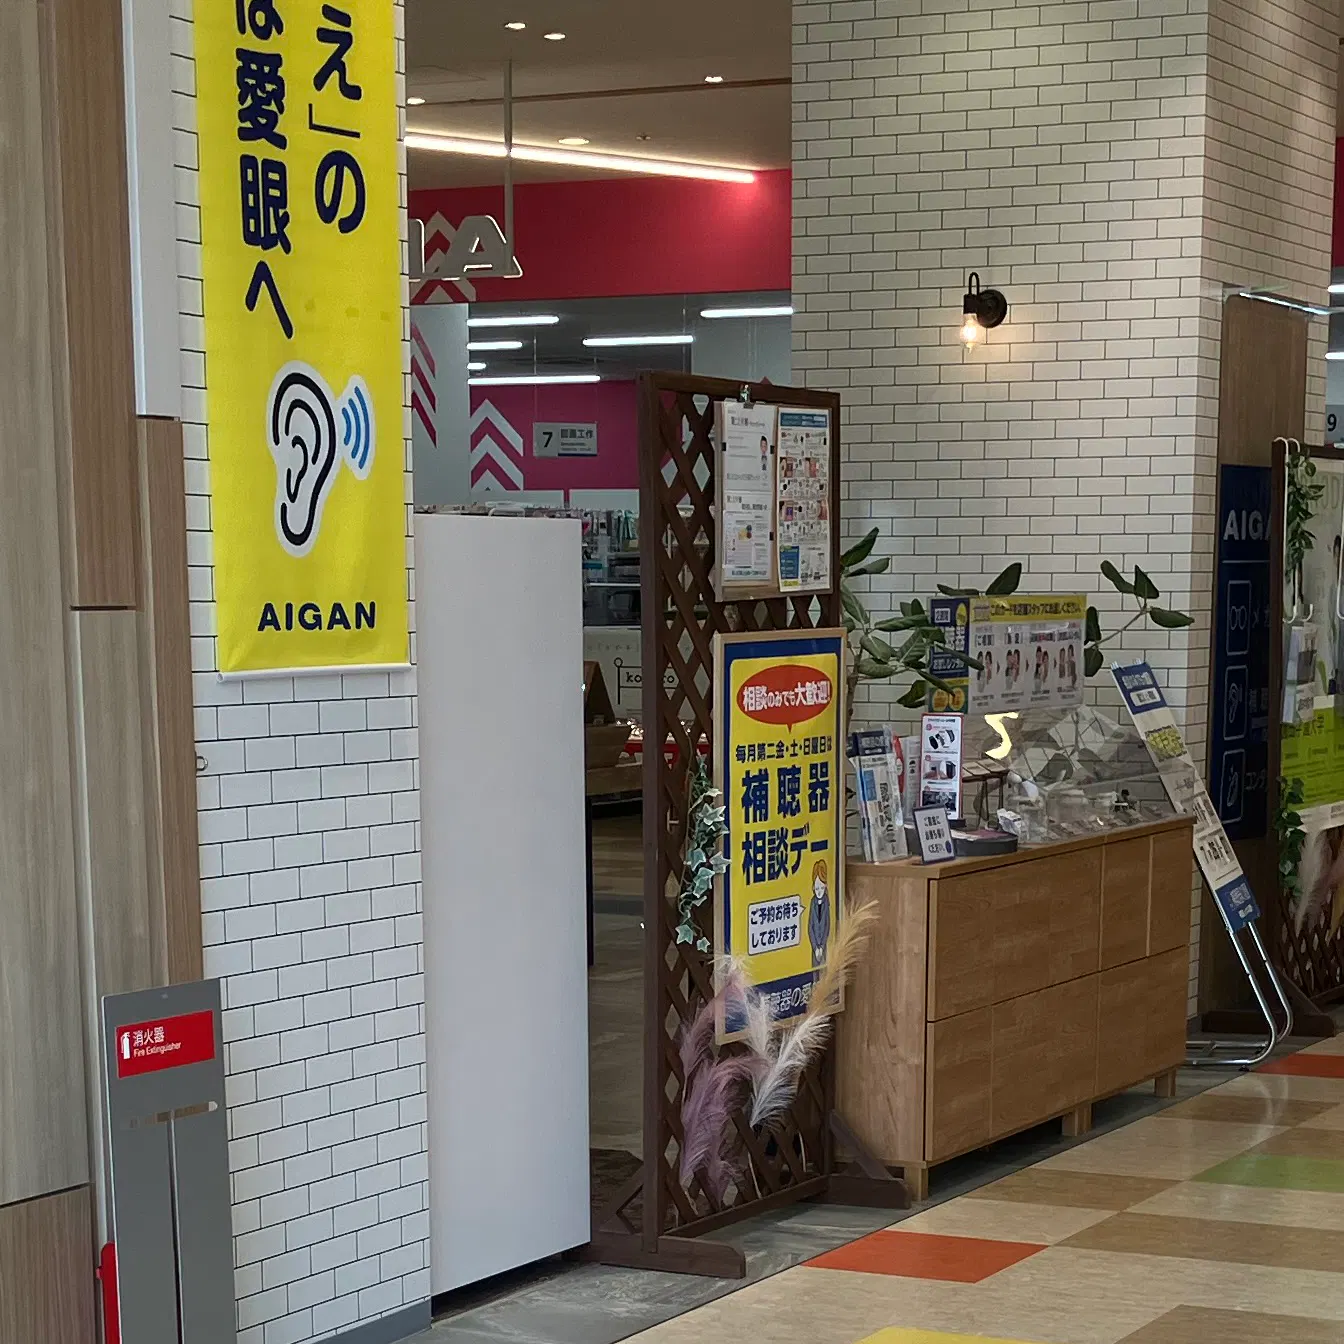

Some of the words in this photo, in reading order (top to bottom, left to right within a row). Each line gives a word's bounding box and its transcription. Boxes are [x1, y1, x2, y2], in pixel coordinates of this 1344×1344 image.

[308, 4, 366, 234] え」の
[1327, 413, 1337, 432] 9
[542, 431, 554, 448] 7
[257, 601, 376, 632] AIGAN
[741, 761, 830, 824] 補聴器
[742, 822, 829, 886] 相談デー
[750, 901, 799, 925] ご予約お待ち
[751, 924, 798, 948] しております
[133, 1026, 165, 1047] 消火器
[133, 1048, 145, 1058] Fire
[146, 1042, 182, 1055] Extinguisher
